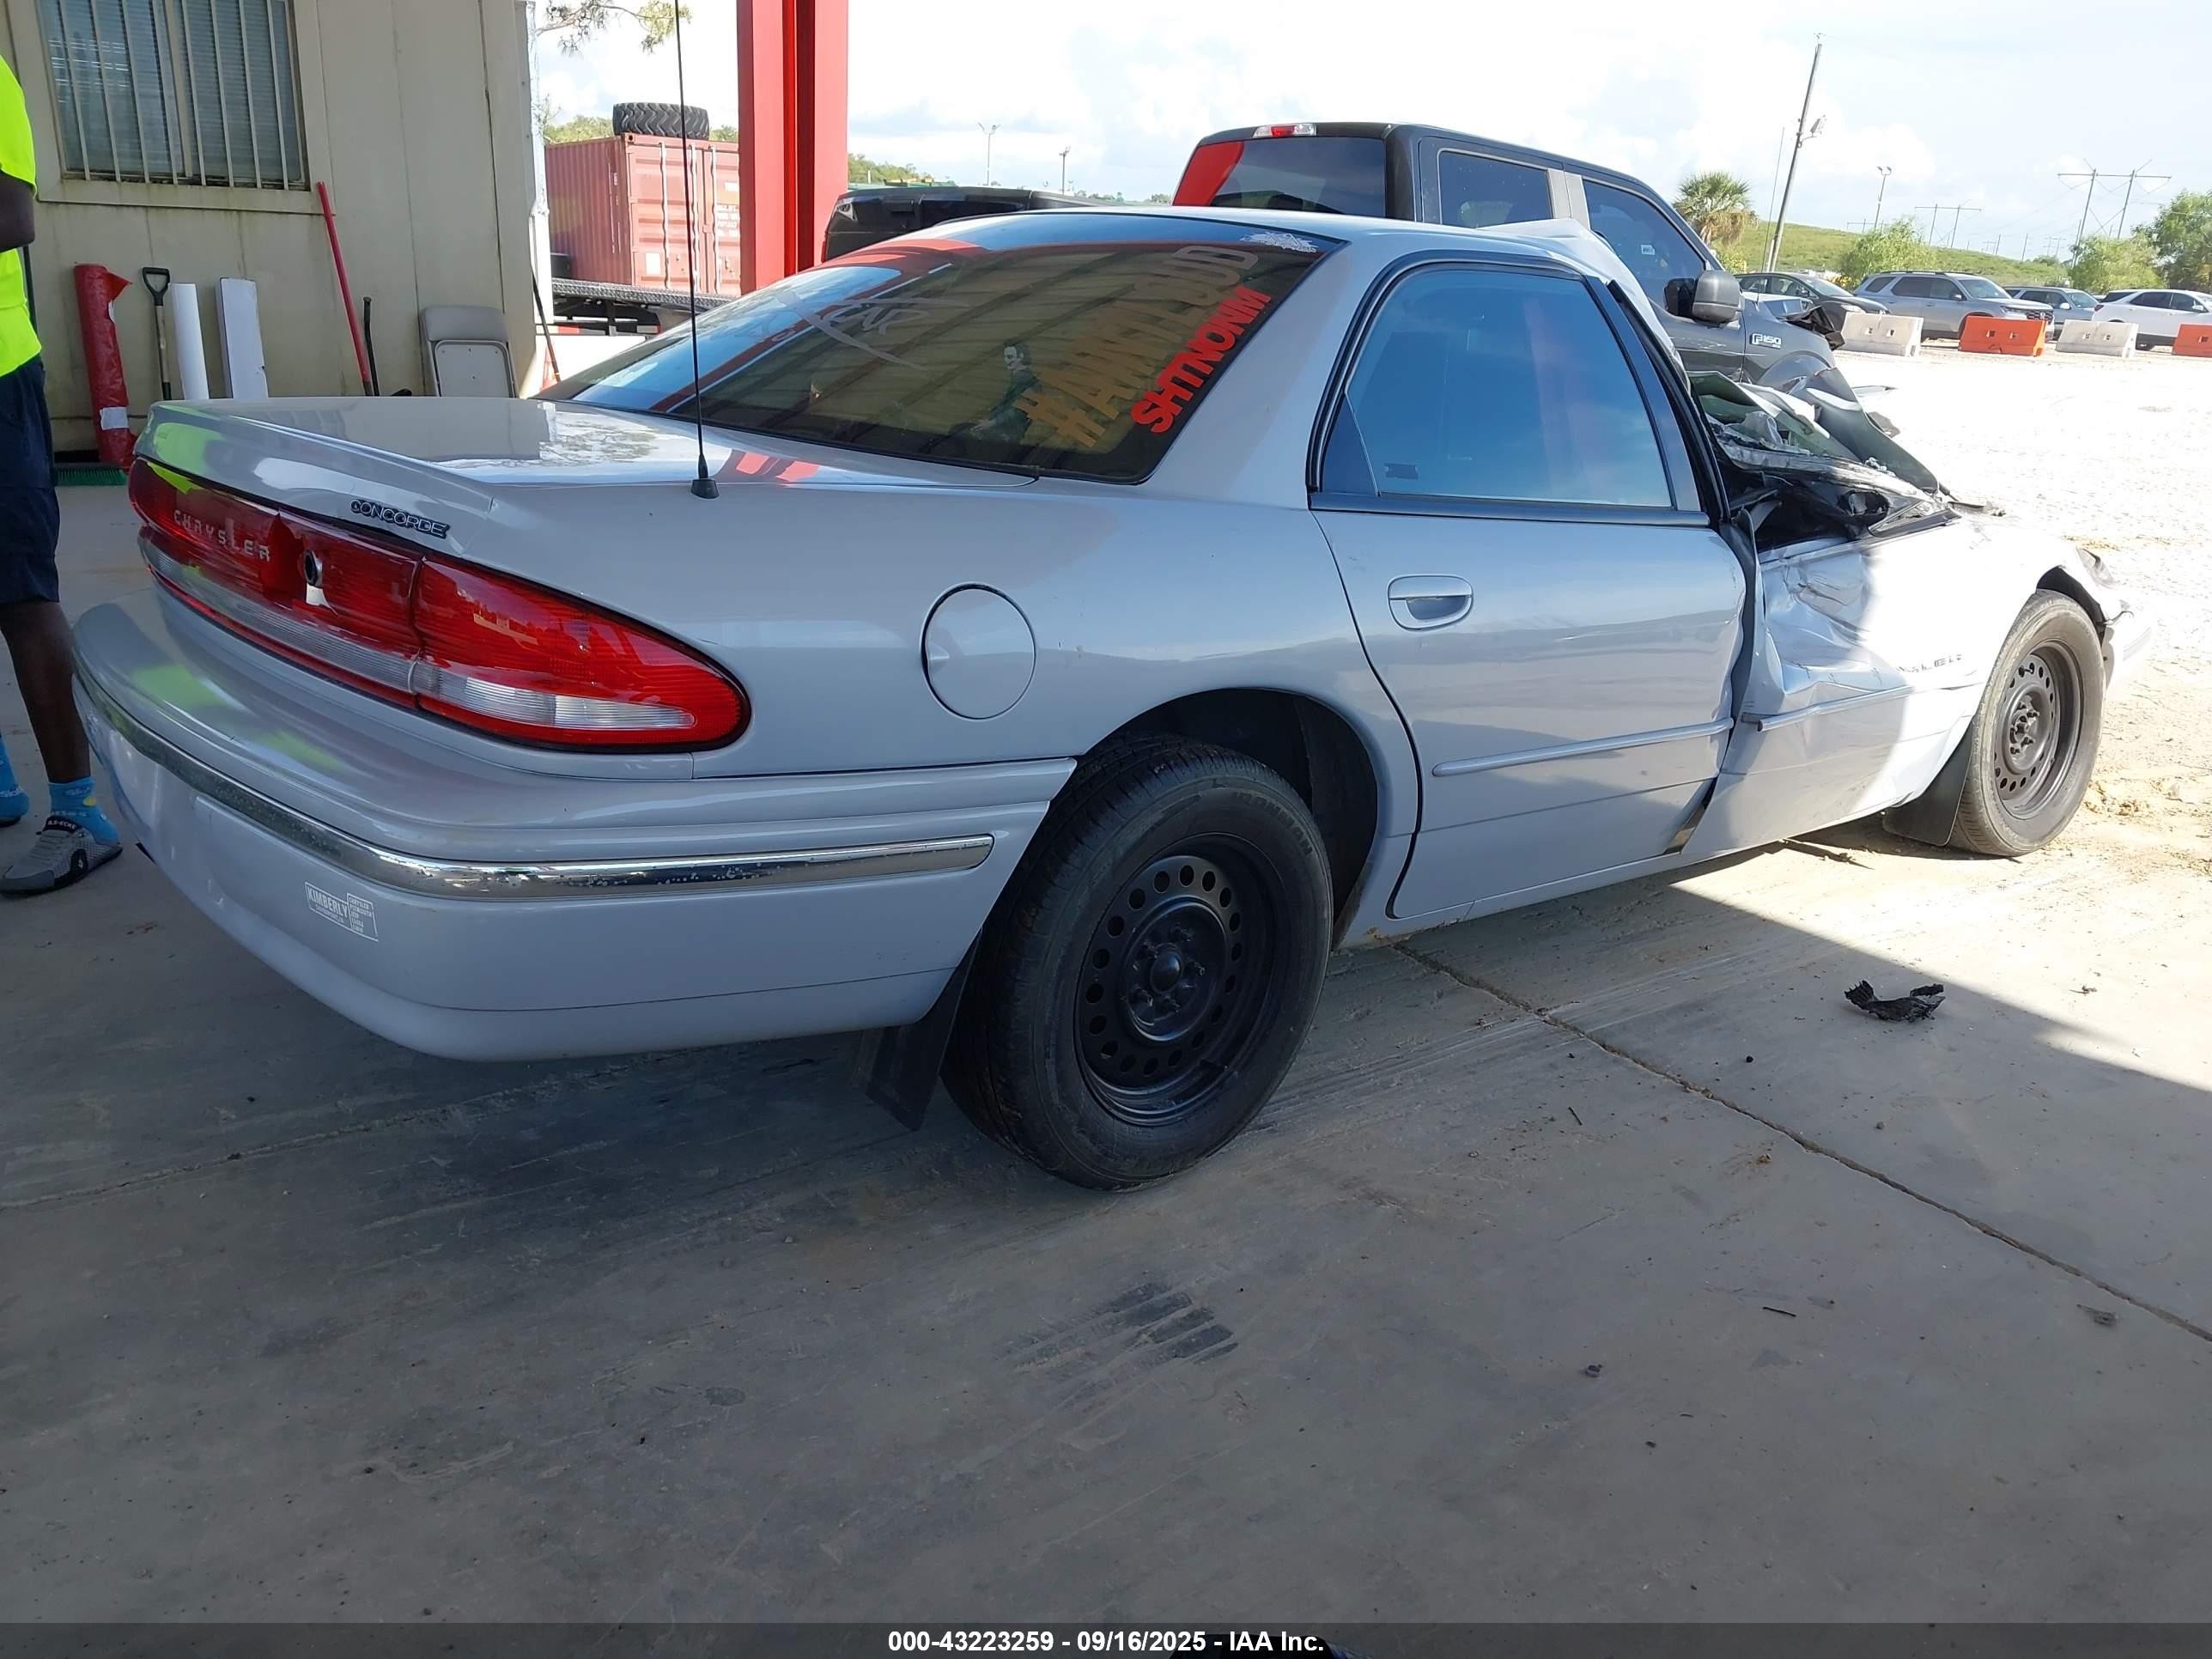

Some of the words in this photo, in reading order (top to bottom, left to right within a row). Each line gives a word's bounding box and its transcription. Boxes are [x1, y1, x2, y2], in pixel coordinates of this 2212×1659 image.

[173, 509, 271, 562] CHRYSLER
[350, 499, 451, 539] CONCORDE
[307, 885, 348, 919] KIMBERLY
